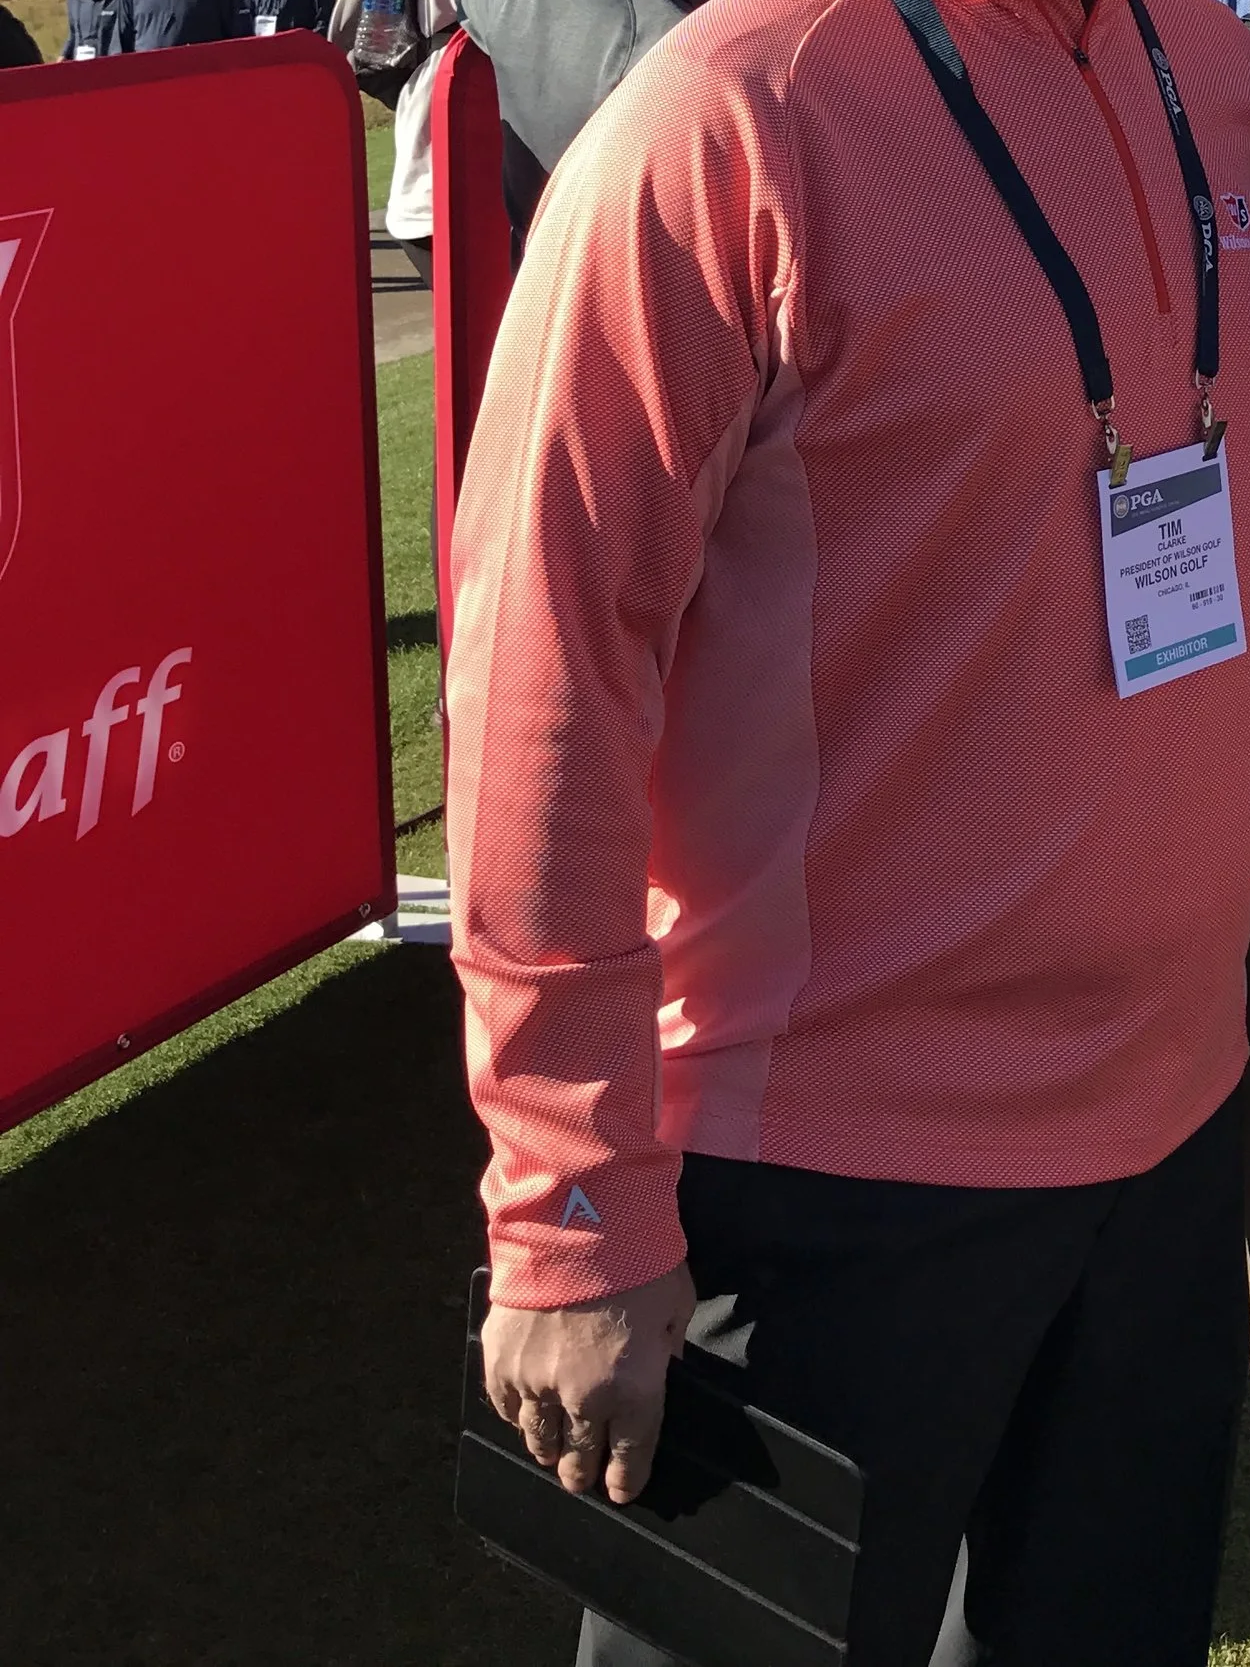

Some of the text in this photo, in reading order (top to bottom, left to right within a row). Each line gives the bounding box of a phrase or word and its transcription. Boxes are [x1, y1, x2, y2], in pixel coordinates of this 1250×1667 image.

[1160, 68, 1182, 117] PGA
[1130, 488, 1164, 511] PGA
[1157, 535, 1187, 552] CLARKE
[1158, 518, 1182, 540] TIM
[1120, 537, 1221, 578] PRESIDENT OF WILSON GOLF
[1135, 554, 1208, 589] WILSON GOLF
[1156, 637, 1208, 666] EXHIBITOR
